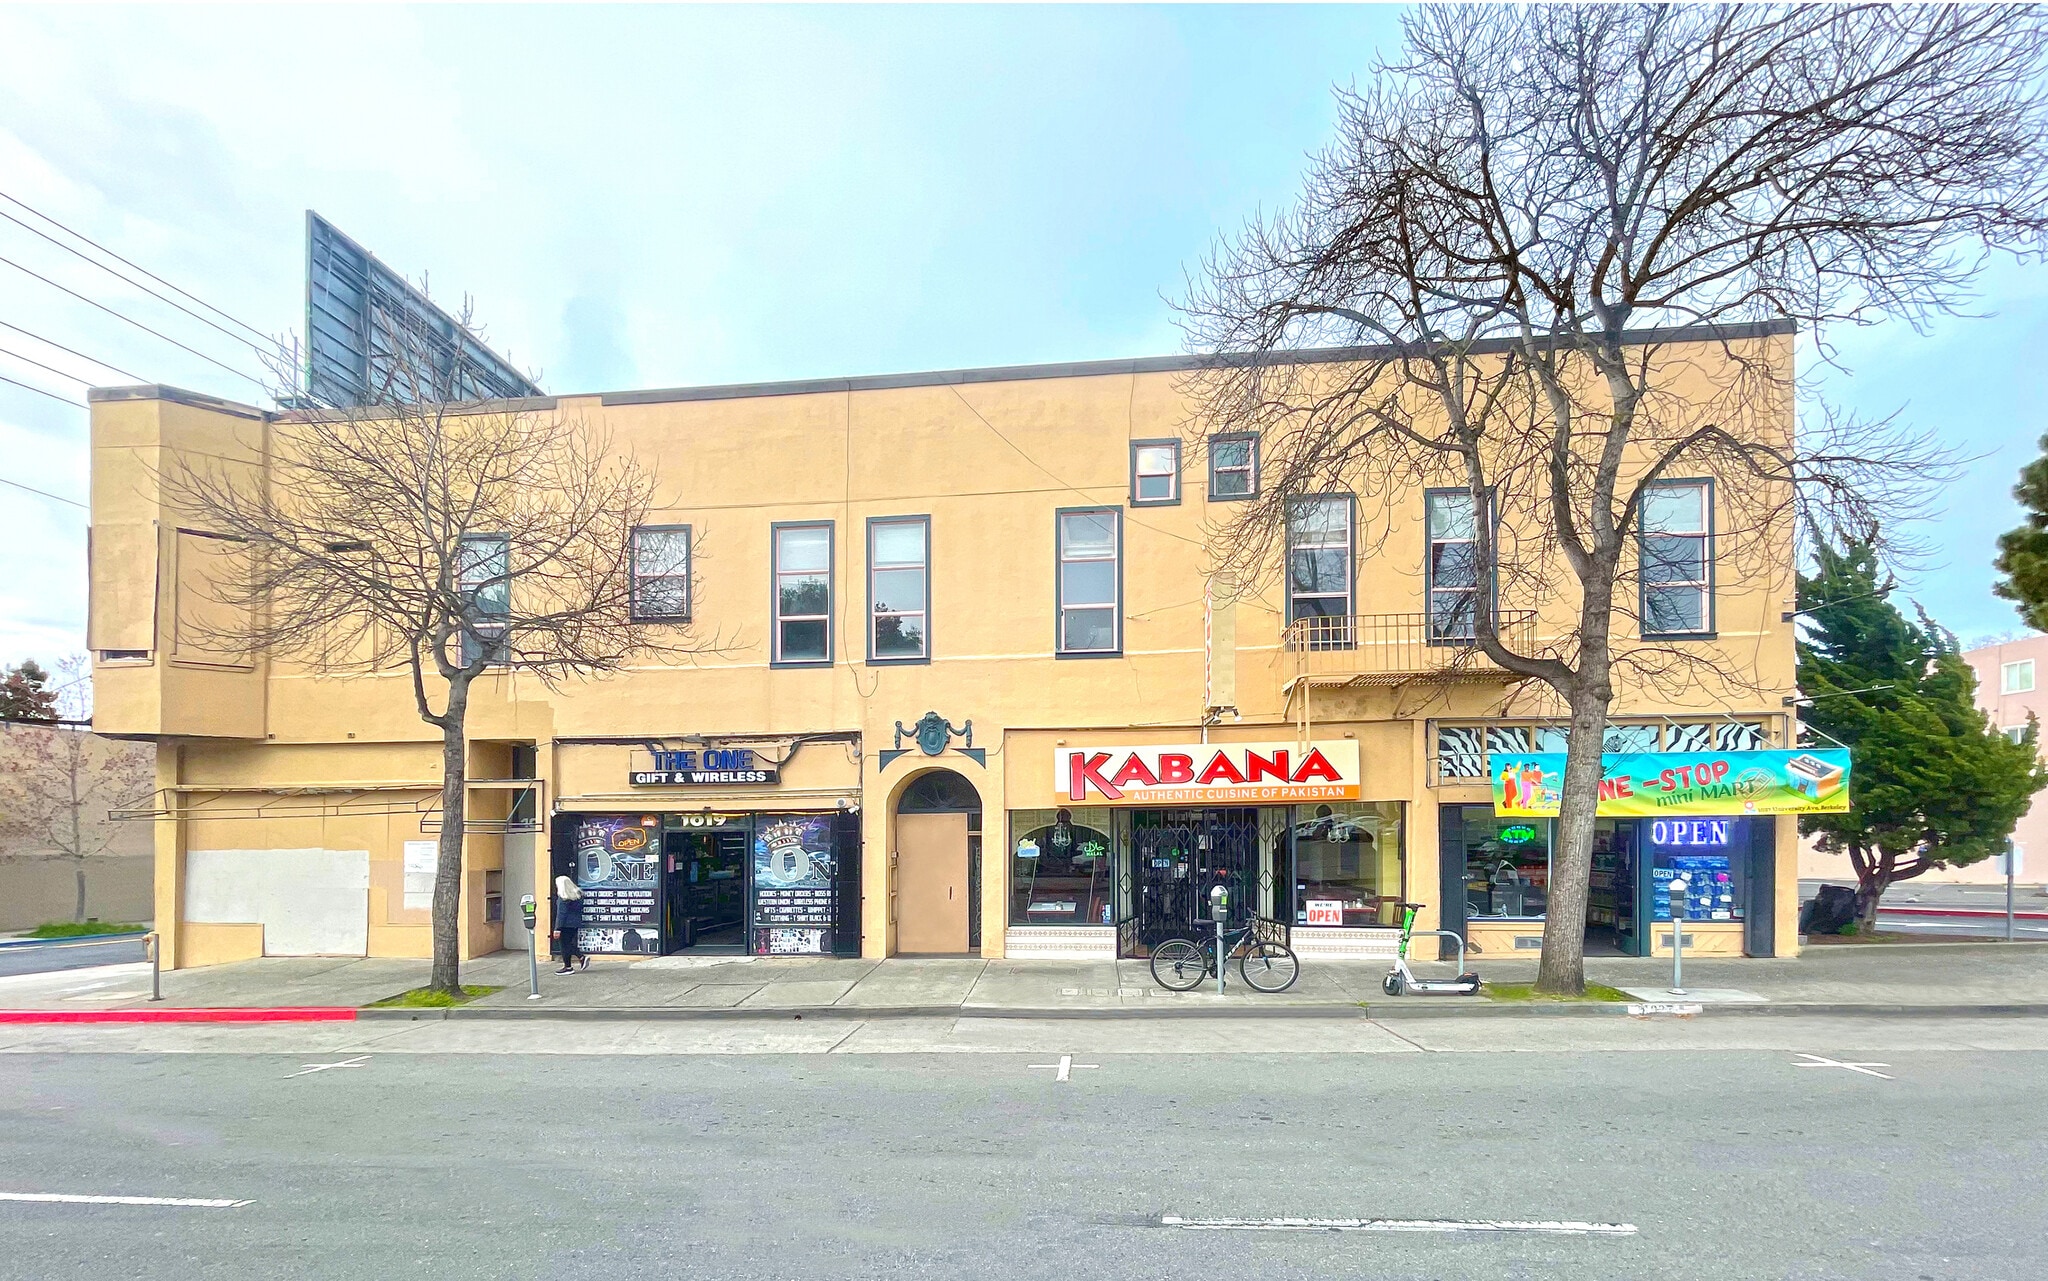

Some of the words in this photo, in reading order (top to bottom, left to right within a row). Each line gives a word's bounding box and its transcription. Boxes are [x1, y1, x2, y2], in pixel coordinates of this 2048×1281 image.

[652, 751, 697, 771] THE
[703, 749, 754, 771] ONE
[635, 772, 668, 784] GIFT
[674, 772, 685, 783] &
[691, 771, 767, 783] WIRELESS
[1069, 746, 1343, 801] KABANA
[1133, 789, 1204, 800] AUTHENTIC
[1206, 788, 1258, 799] CUISINE
[1261, 788, 1278, 798] OF
[1281, 787, 1345, 798] PAKISTAN
[1597, 775, 1634, 801] NE
[1656, 788, 1694, 807] mini
[1701, 778, 1756, 800] MART
[681, 815, 727, 828] 1019
[1500, 829, 1535, 840] ATM
[1652, 821, 1729, 845] OPEN
[618, 838, 640, 847] OPEN
[578, 846, 655, 884] ONE
[1653, 869, 1672, 878] OPEN
[1309, 909, 1340, 922] OPEN
